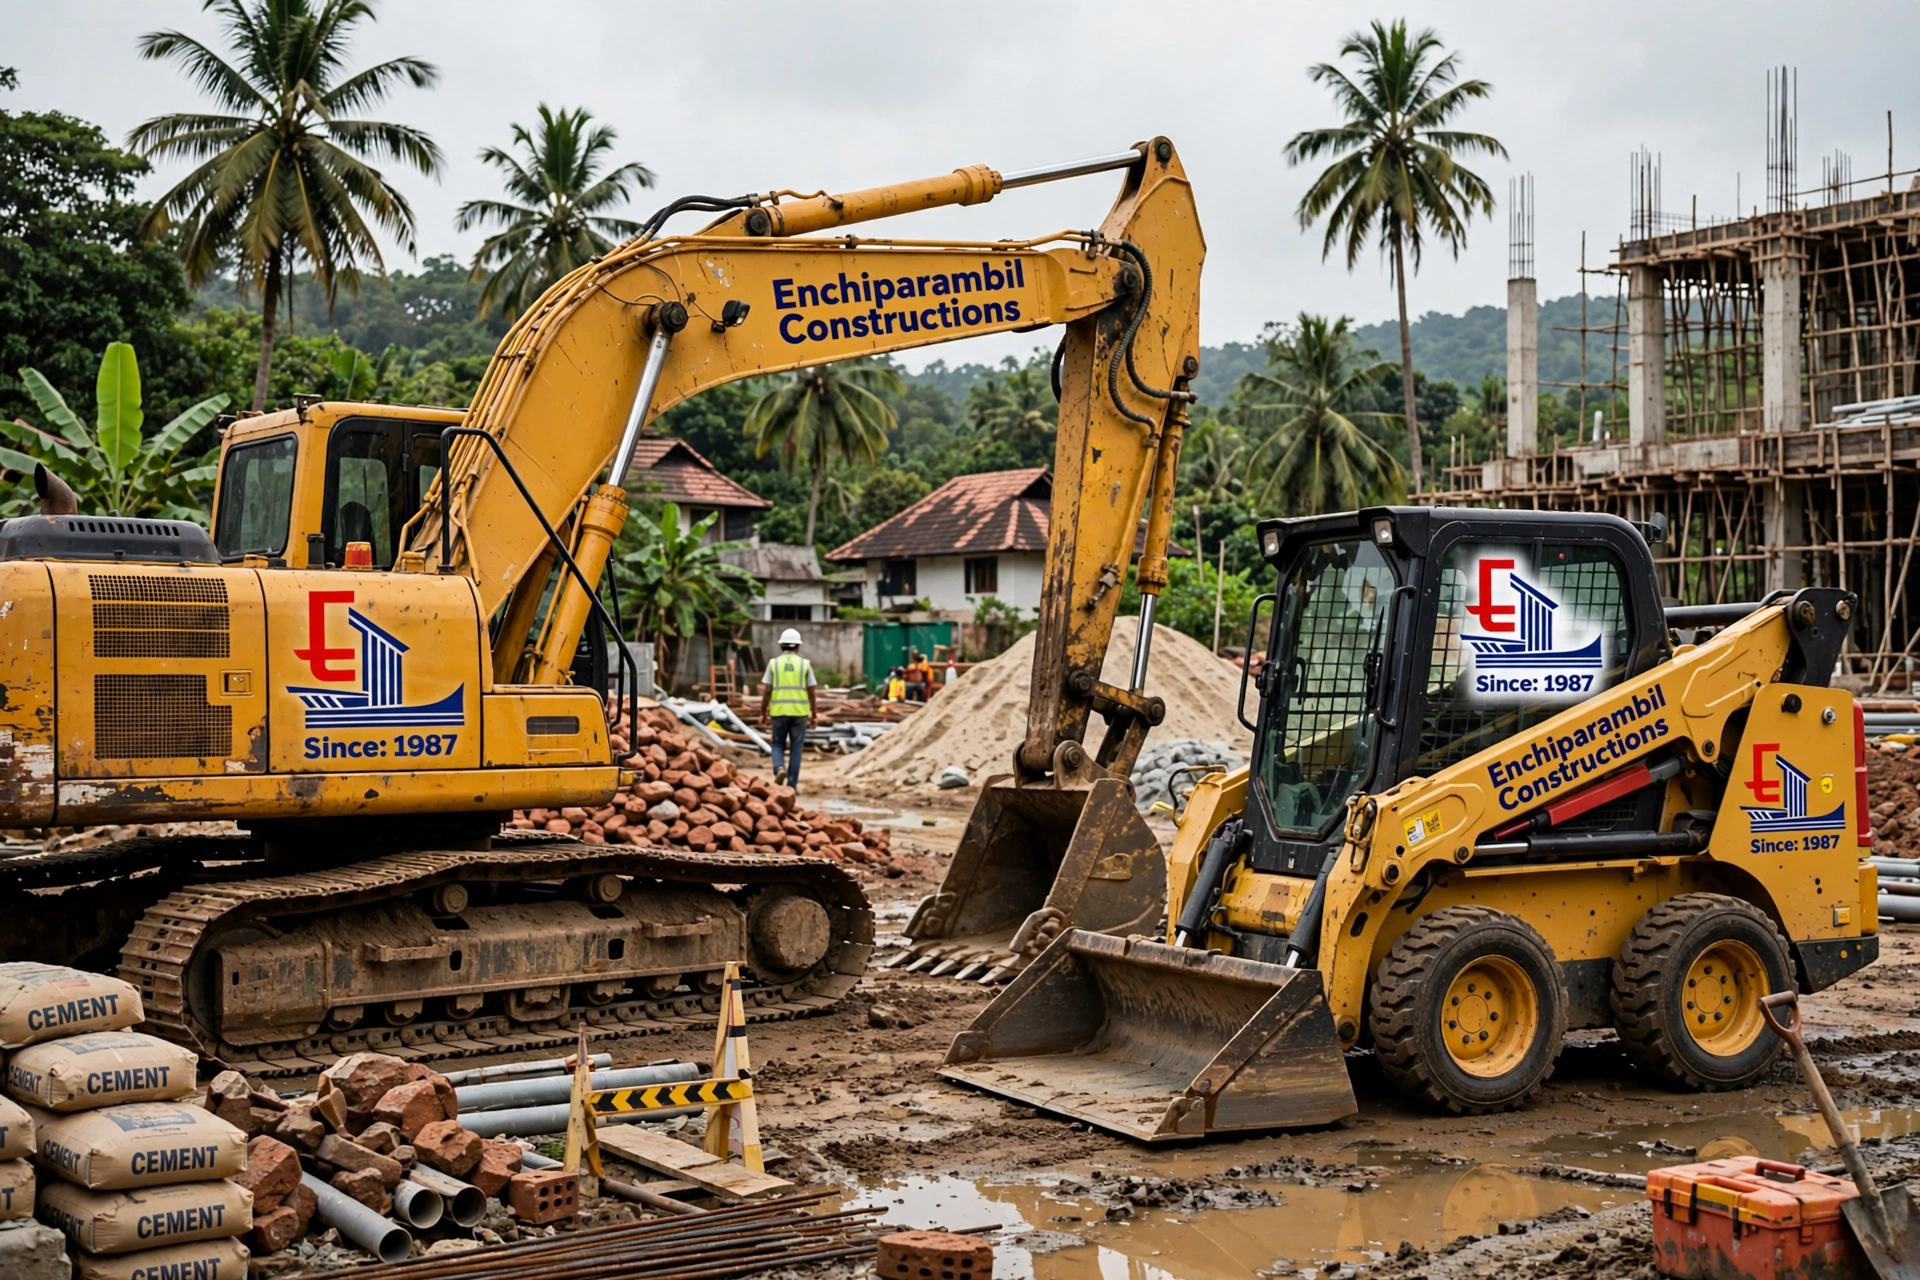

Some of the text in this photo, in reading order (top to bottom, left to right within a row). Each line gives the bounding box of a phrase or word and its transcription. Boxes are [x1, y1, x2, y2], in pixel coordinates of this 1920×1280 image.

[773, 258, 1025, 310] Enchiparambil
[779, 297, 1021, 344] Constructions
[1476, 674, 1594, 692] Since: 1987
[303, 734, 458, 758] Since: 1987
[1487, 683, 1667, 788] Enchiparambil
[1498, 717, 1669, 811] Constructions
[1750, 834, 1840, 854] Since: 1987
[27, 994, 119, 1031] CEMENT
[86, 1066, 170, 1095] CEMENT
[43, 1139, 81, 1175] CEMENT
[131, 1145, 218, 1175] CEMENT
[137, 1204, 225, 1239] CEMENT
